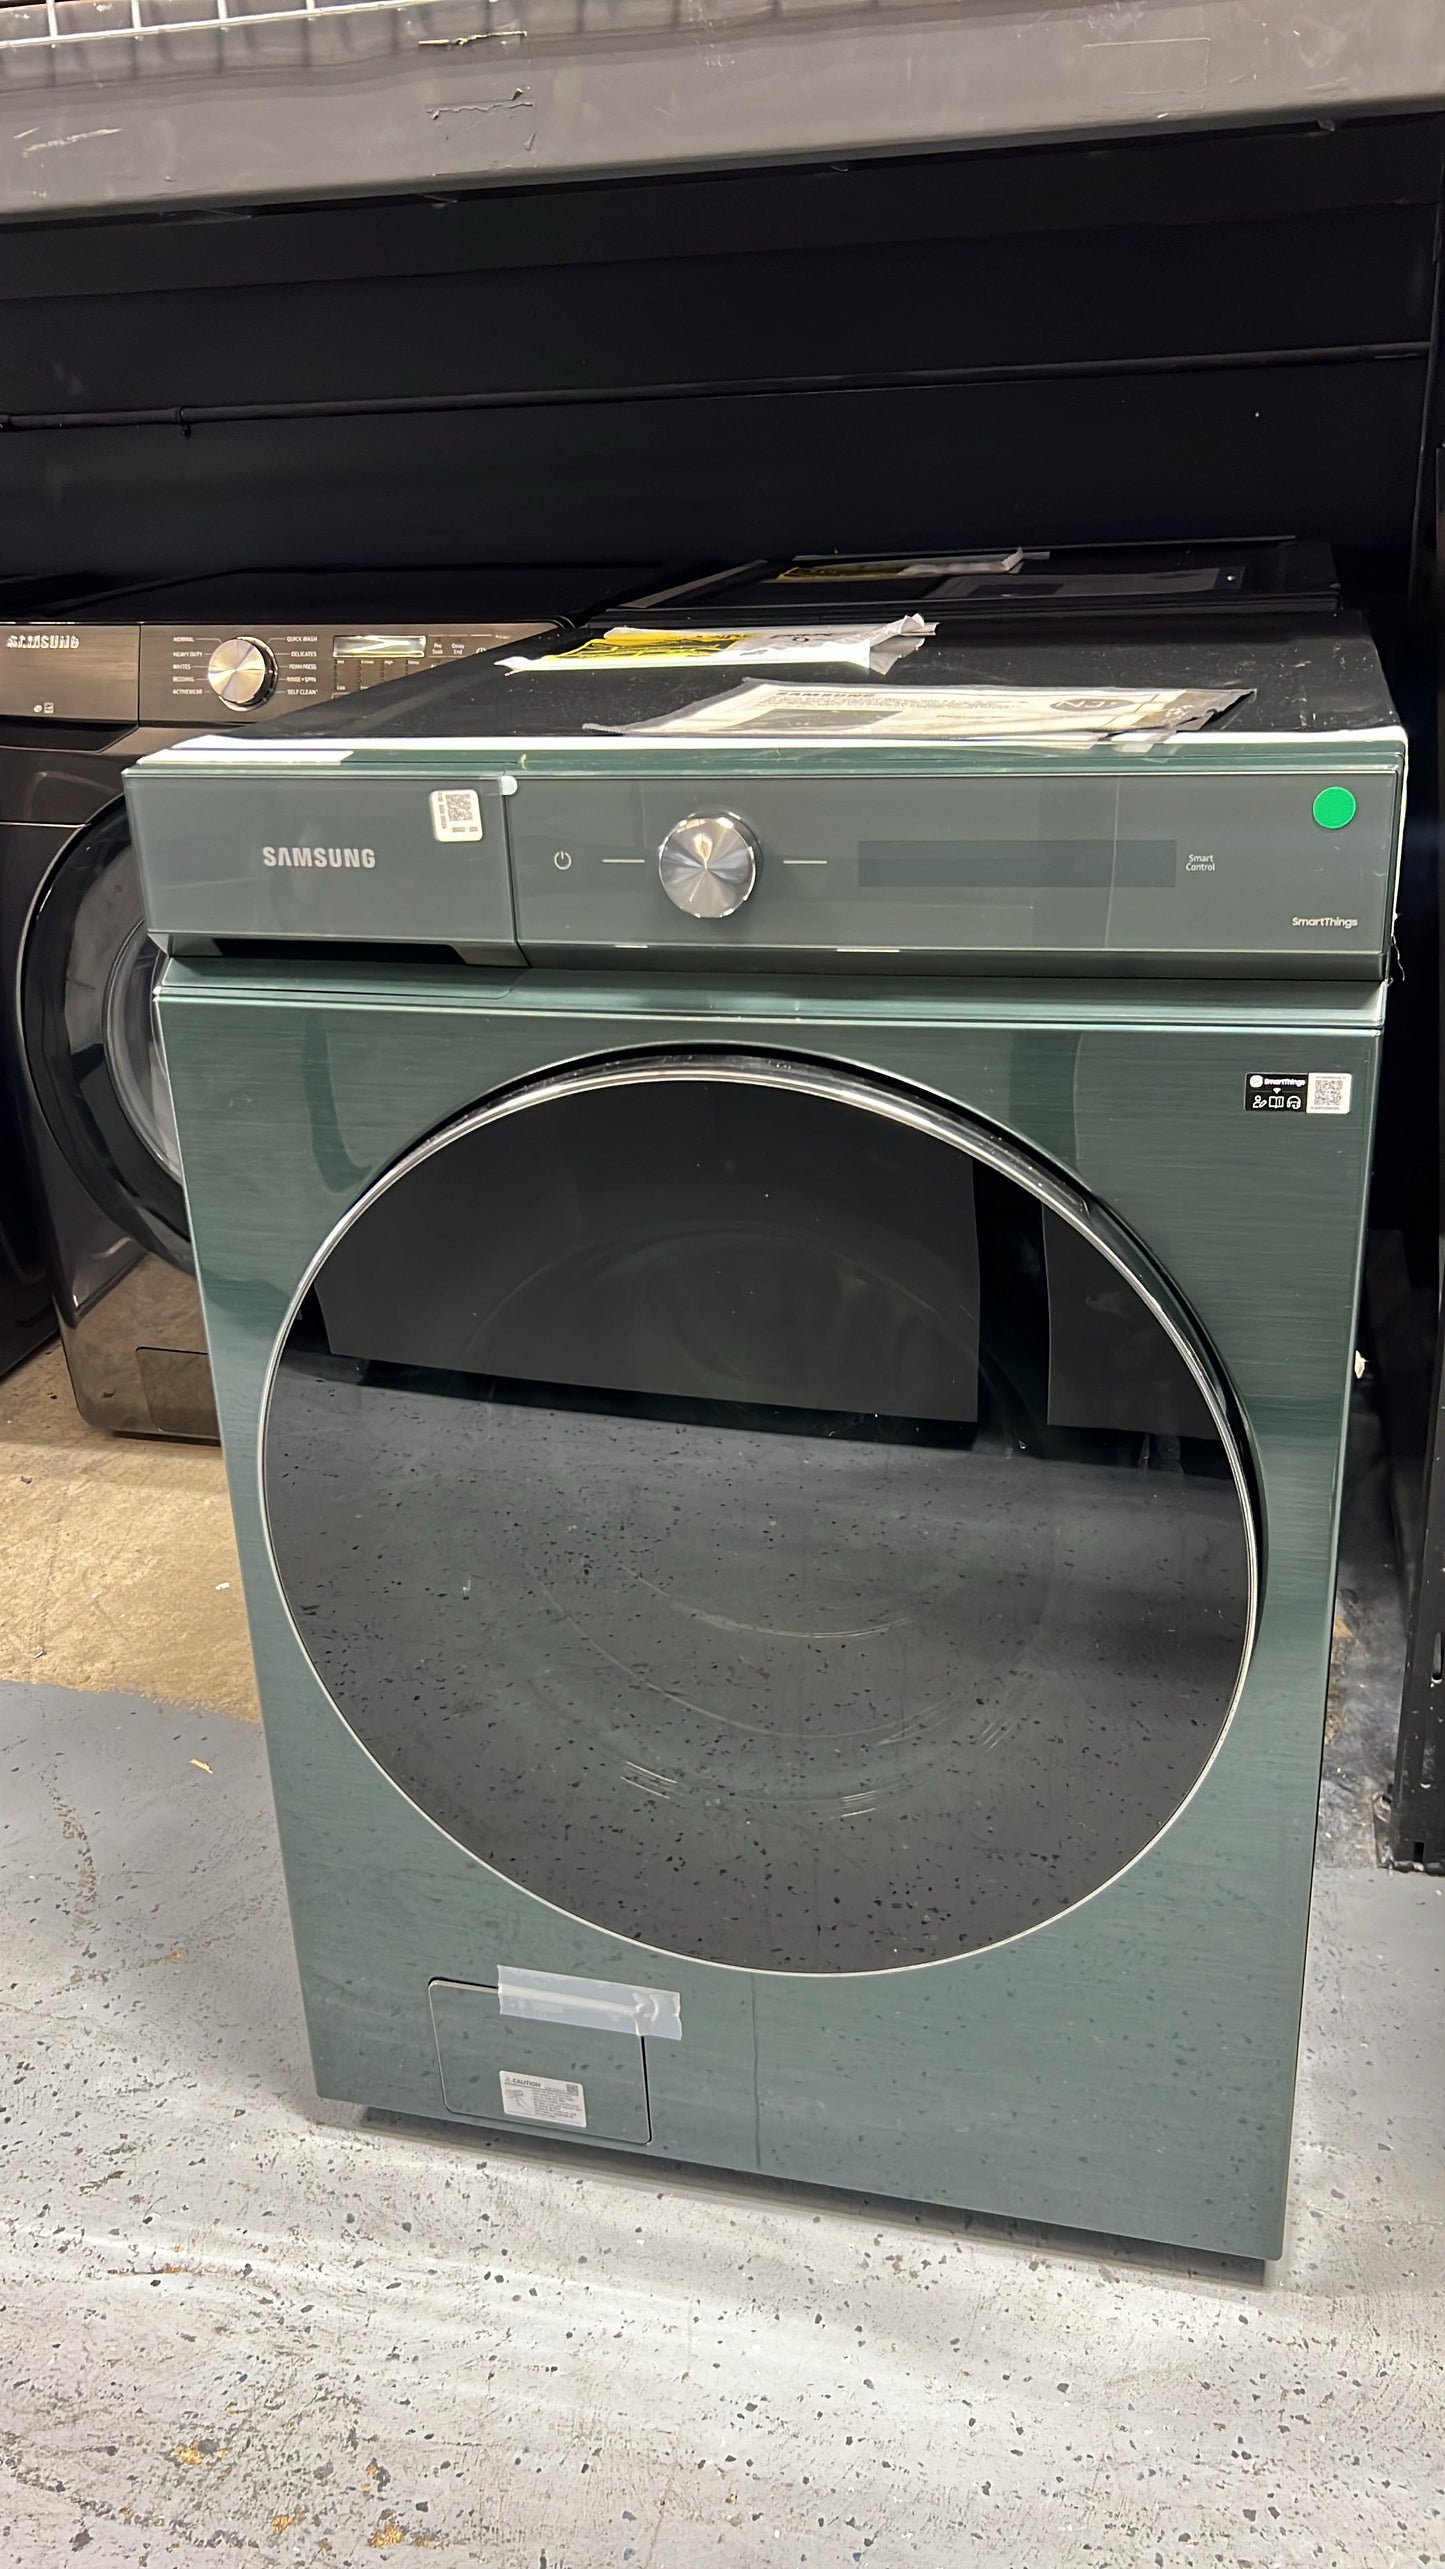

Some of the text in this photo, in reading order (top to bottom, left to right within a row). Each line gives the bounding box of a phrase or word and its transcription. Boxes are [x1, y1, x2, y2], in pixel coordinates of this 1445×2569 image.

[6, 635, 80, 649] SAMSUNG
[262, 846, 376, 869] SAMSUNG
[1188, 854, 1214, 863] Smart
[1185, 862, 1216, 872] Control
[1291, 916, 1358, 929] SmartThings
[1263, 1078, 1306, 1088] SmartThings
[512, 2078, 541, 2088] CAUTION
